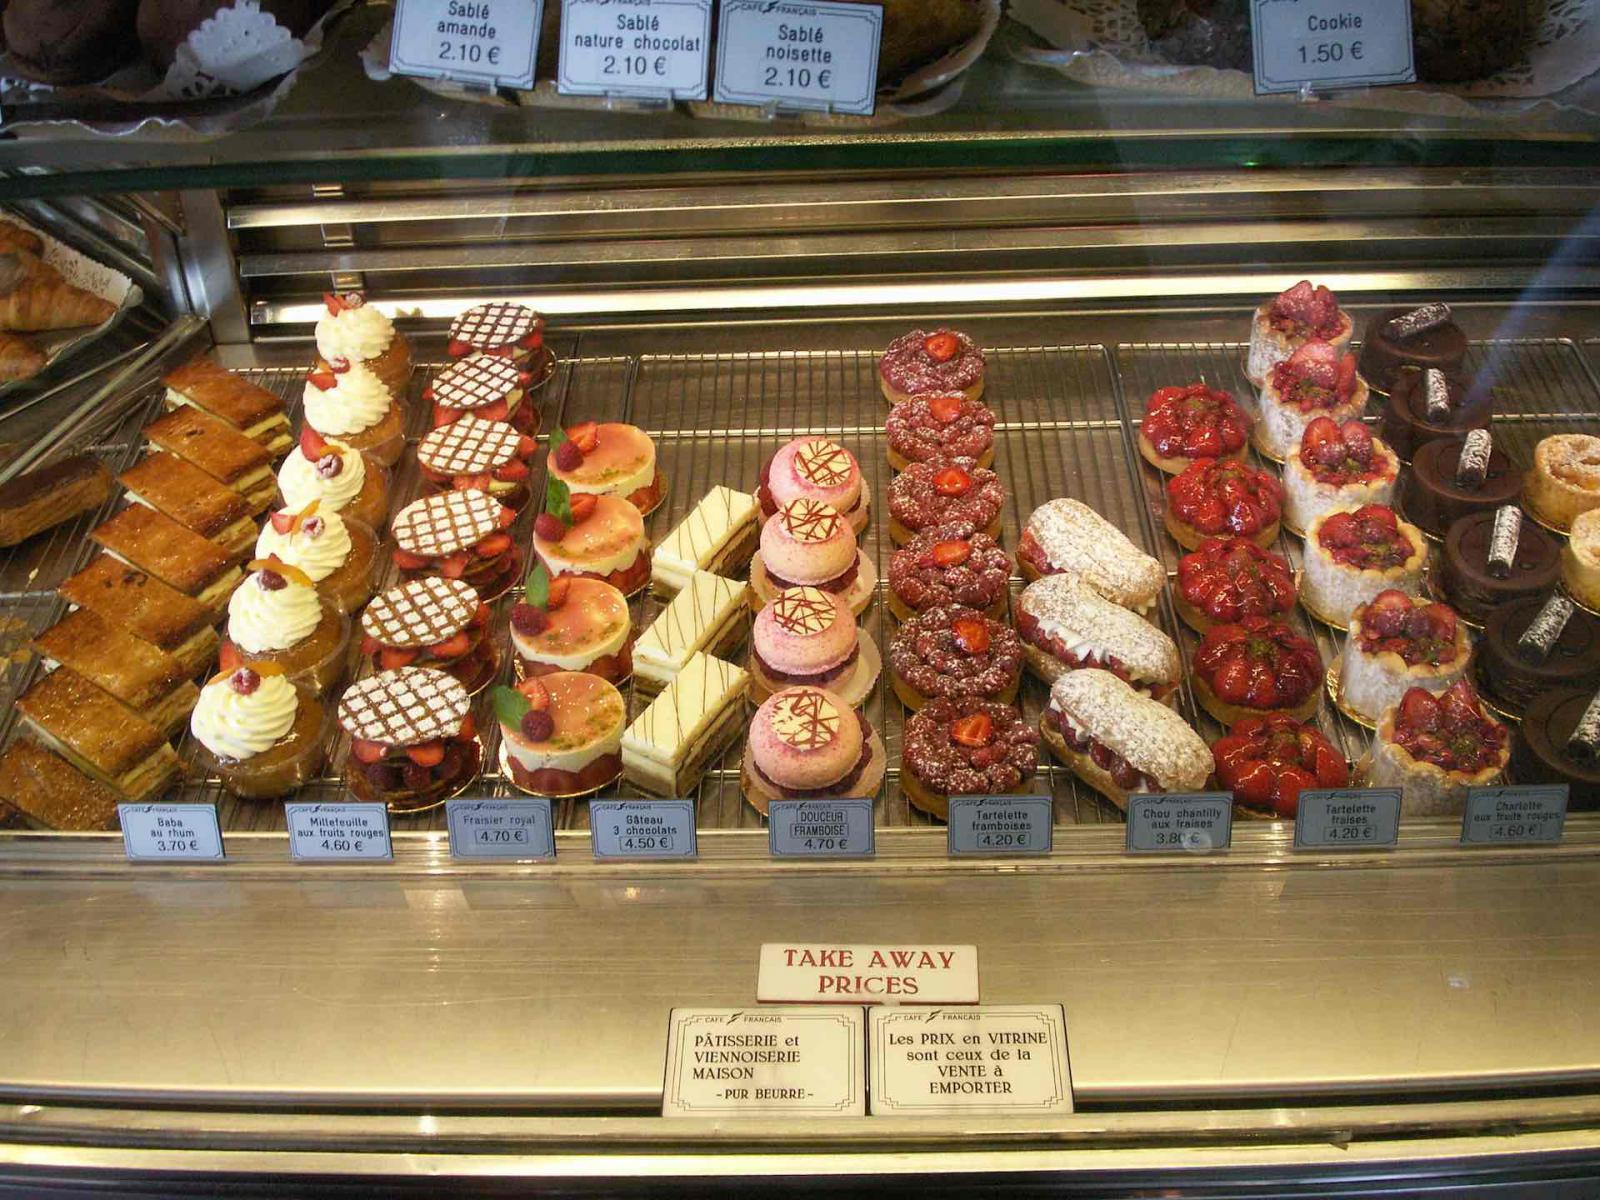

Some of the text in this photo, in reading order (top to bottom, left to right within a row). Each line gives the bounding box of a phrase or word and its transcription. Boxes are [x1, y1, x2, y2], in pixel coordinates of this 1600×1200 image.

[448, 1, 490, 20] Sablé
[617, 13, 660, 31] Sablé
[1307, 13, 1363, 31] Cookie
[437, 20, 497, 39] amande
[778, 24, 824, 43] Sablé
[575, 34, 701, 52] nature chocolat
[439, 41, 501, 65] 2.10 €
[766, 44, 832, 64] noisette
[1298, 41, 1364, 64] 1.50 €
[603, 55, 667, 76] 2.10 €
[764, 67, 832, 89] 2.10 €
[1326, 804, 1376, 814] Tartelette
[1496, 801, 1542, 811] Charlotte
[800, 811, 844, 822] DOUCEUR
[976, 810, 1028, 820] Tartelette
[1143, 808, 1222, 819] Chou chantilly
[158, 818, 183, 828] Baba
[310, 817, 368, 827] Millefeuille
[463, 815, 536, 826] Fraisier royal
[626, 815, 663, 824] Gâteau
[1151, 821, 1170, 829] aux
[1332, 815, 1368, 824] fraises
[613, 826, 678, 836] 3 chocolats
[794, 825, 845, 836] FRAMBOISE
[972, 821, 1032, 831] framboises
[168, 829, 195, 837] rhum
[320, 829, 345, 837] fruits
[350, 829, 384, 839] rouges
[480, 830, 523, 841] 4.70 €
[1329, 827, 1372, 839] 4.20 €
[158, 840, 200, 851] 3.70 €
[321, 840, 364, 851] 4.60 €
[625, 838, 668, 849] 4.50 €
[804, 839, 848, 849] 4.70 €
[982, 835, 1026, 846] 4.20 €
[784, 949, 955, 969] TAKE AWAY
[818, 976, 919, 995] PRICES
[695, 1032, 799, 1047] PÂTISSERIE et
[889, 1032, 1048, 1045] Les PRIX en VITRINE
[695, 1051, 800, 1063] VIENNOISERIE
[907, 1049, 1031, 1061] sont ceux de la
[693, 1067, 754, 1079] MAISON
[938, 1065, 1003, 1077] VENTE à
[930, 1082, 1012, 1094] EMPORTER
